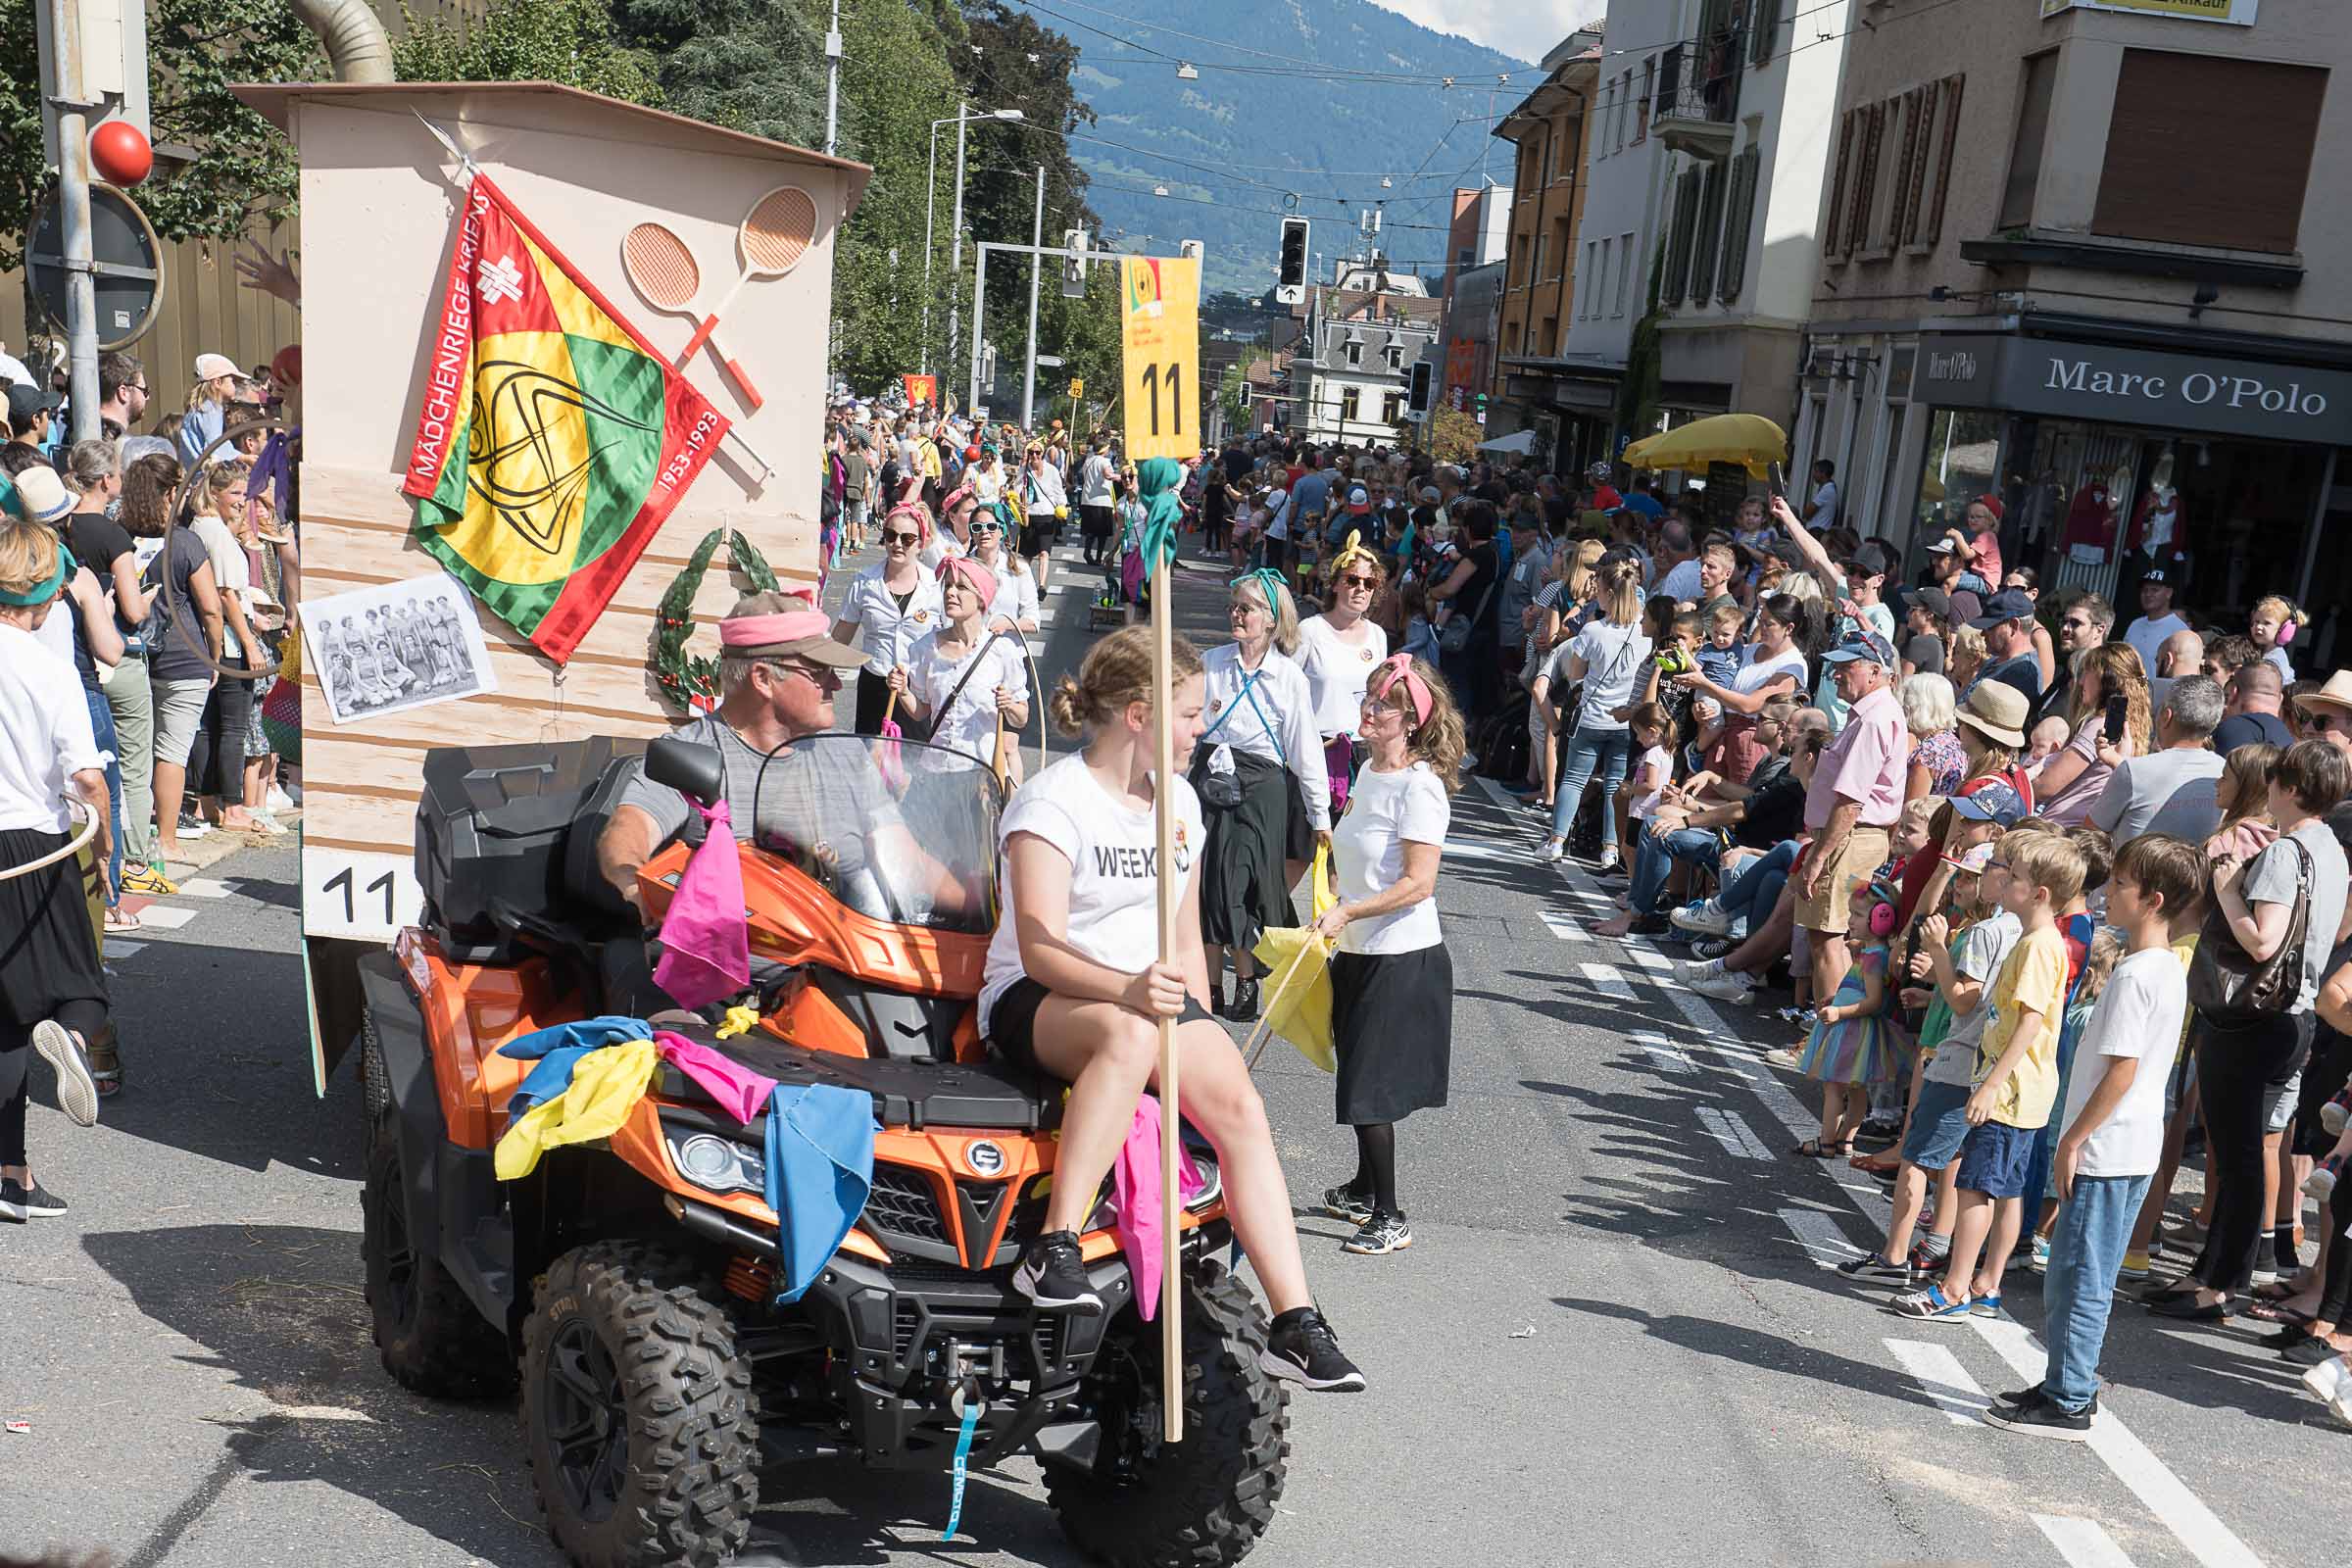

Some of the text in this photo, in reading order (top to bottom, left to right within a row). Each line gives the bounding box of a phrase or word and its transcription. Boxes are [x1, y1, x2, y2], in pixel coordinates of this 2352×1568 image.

[415, 187, 491, 478] MÄDCHENRIEGE KRIENS
[1072, 387, 1082, 397] 12
[1142, 363, 1181, 436] 11
[2044, 358, 2328, 416] Marc O'Polo
[658, 411, 718, 495] 1953-1993
[1094, 844, 1191, 878] WEEKD
[322, 866, 395, 925] 11
